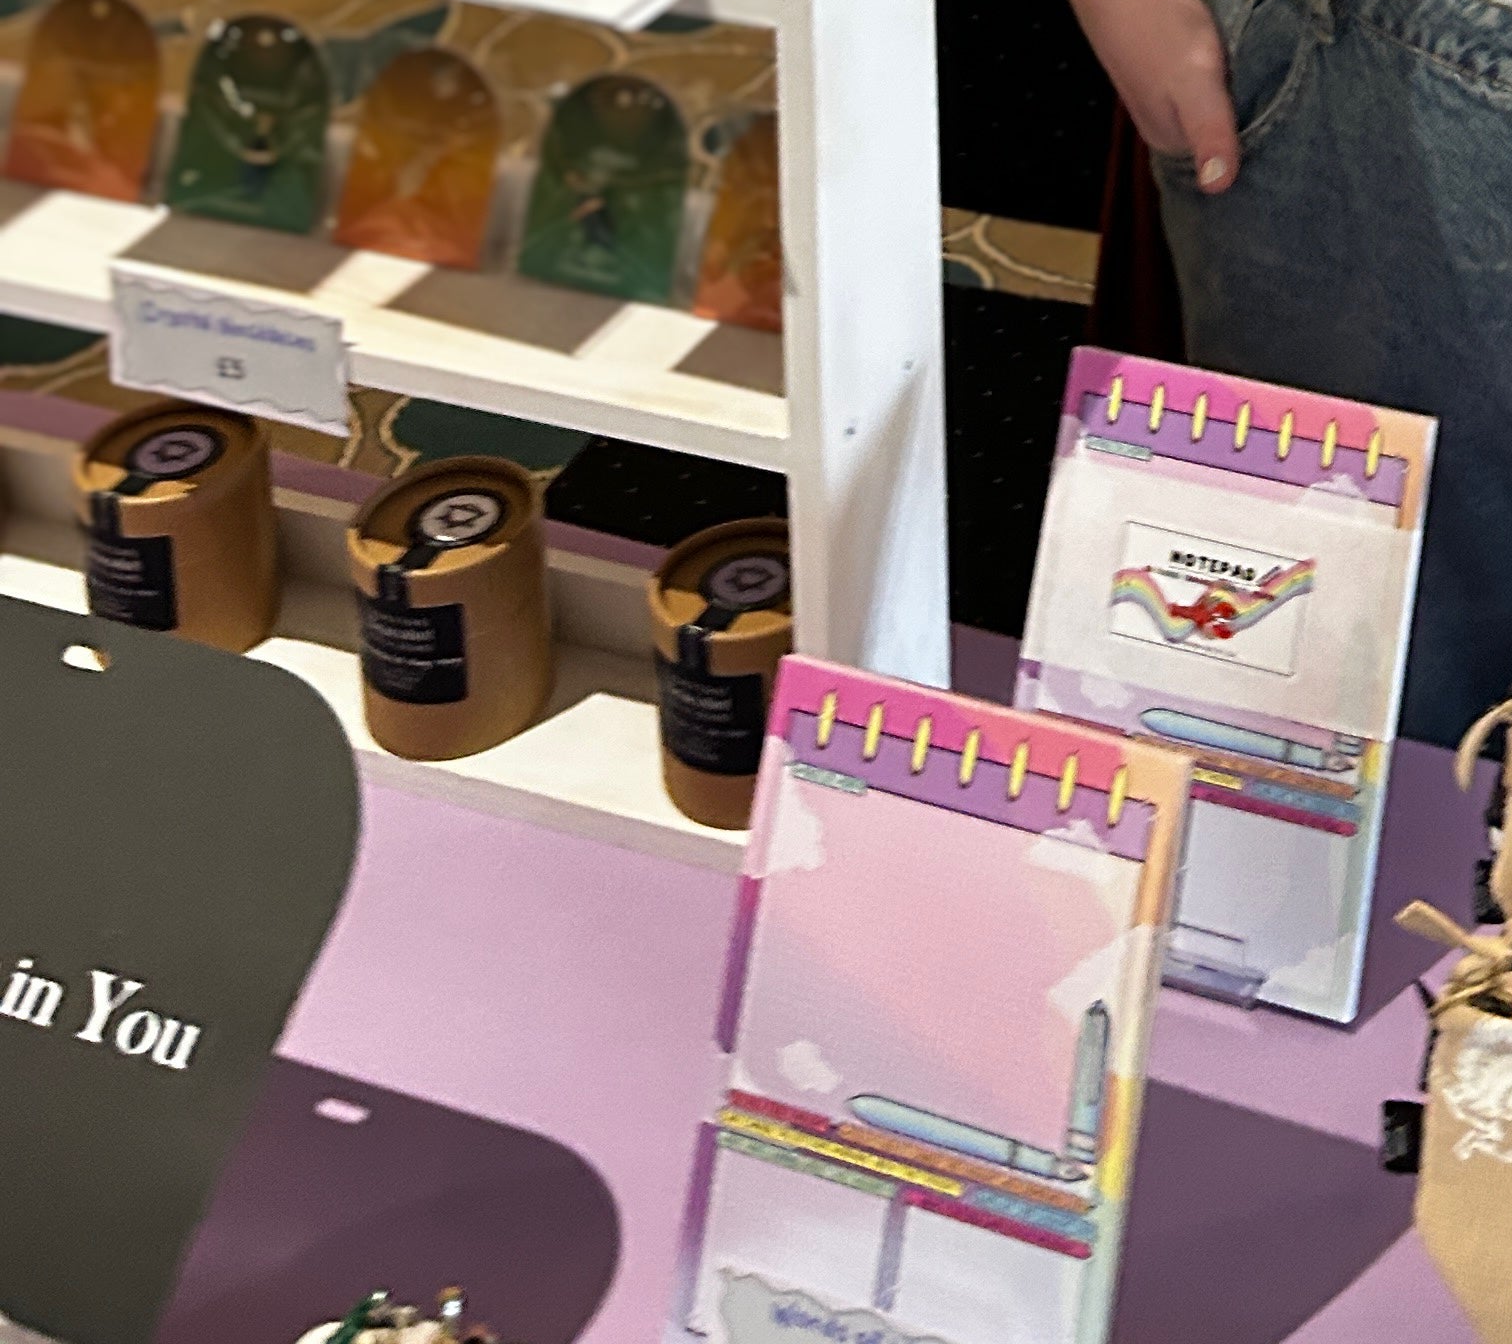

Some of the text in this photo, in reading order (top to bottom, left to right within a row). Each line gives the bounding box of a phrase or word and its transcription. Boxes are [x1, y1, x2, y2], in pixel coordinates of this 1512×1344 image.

[1169, 549, 1256, 583] NOTEPAD
[0, 958, 201, 1070] in You
